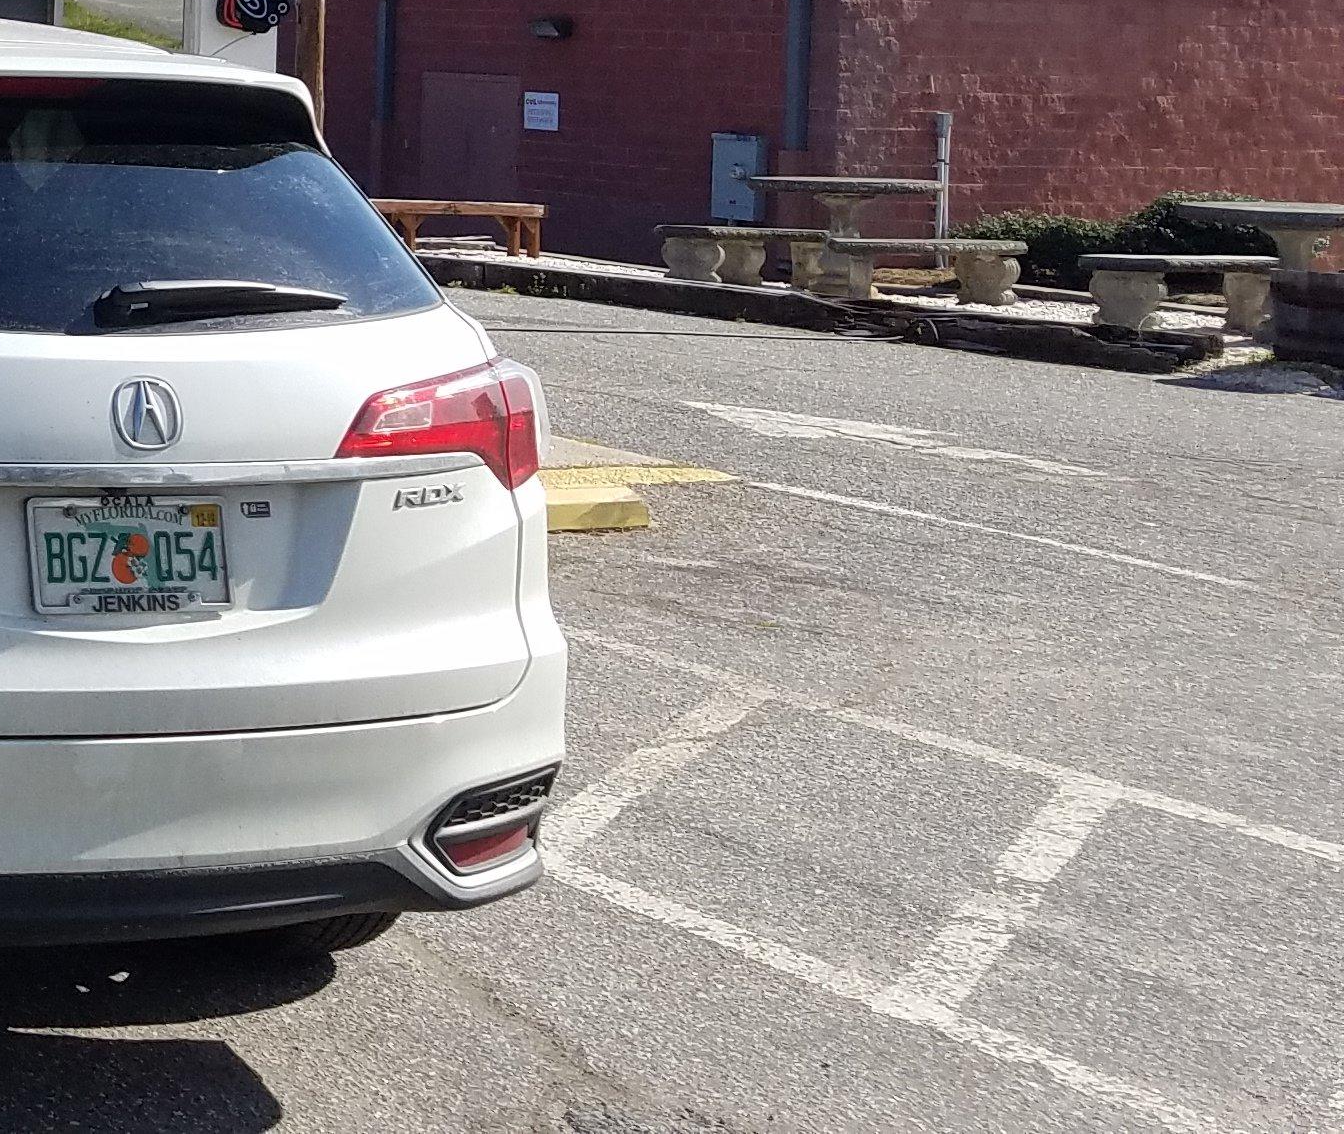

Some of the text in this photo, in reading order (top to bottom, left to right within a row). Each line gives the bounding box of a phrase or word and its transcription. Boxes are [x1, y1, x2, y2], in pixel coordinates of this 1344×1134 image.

[100, 495, 155, 507] OCALA
[392, 483, 466, 512] RDX
[74, 506, 184, 527] MYFLORIDA.COM
[44, 532, 111, 584] BGZ
[93, 594, 180, 613] JENKINS
